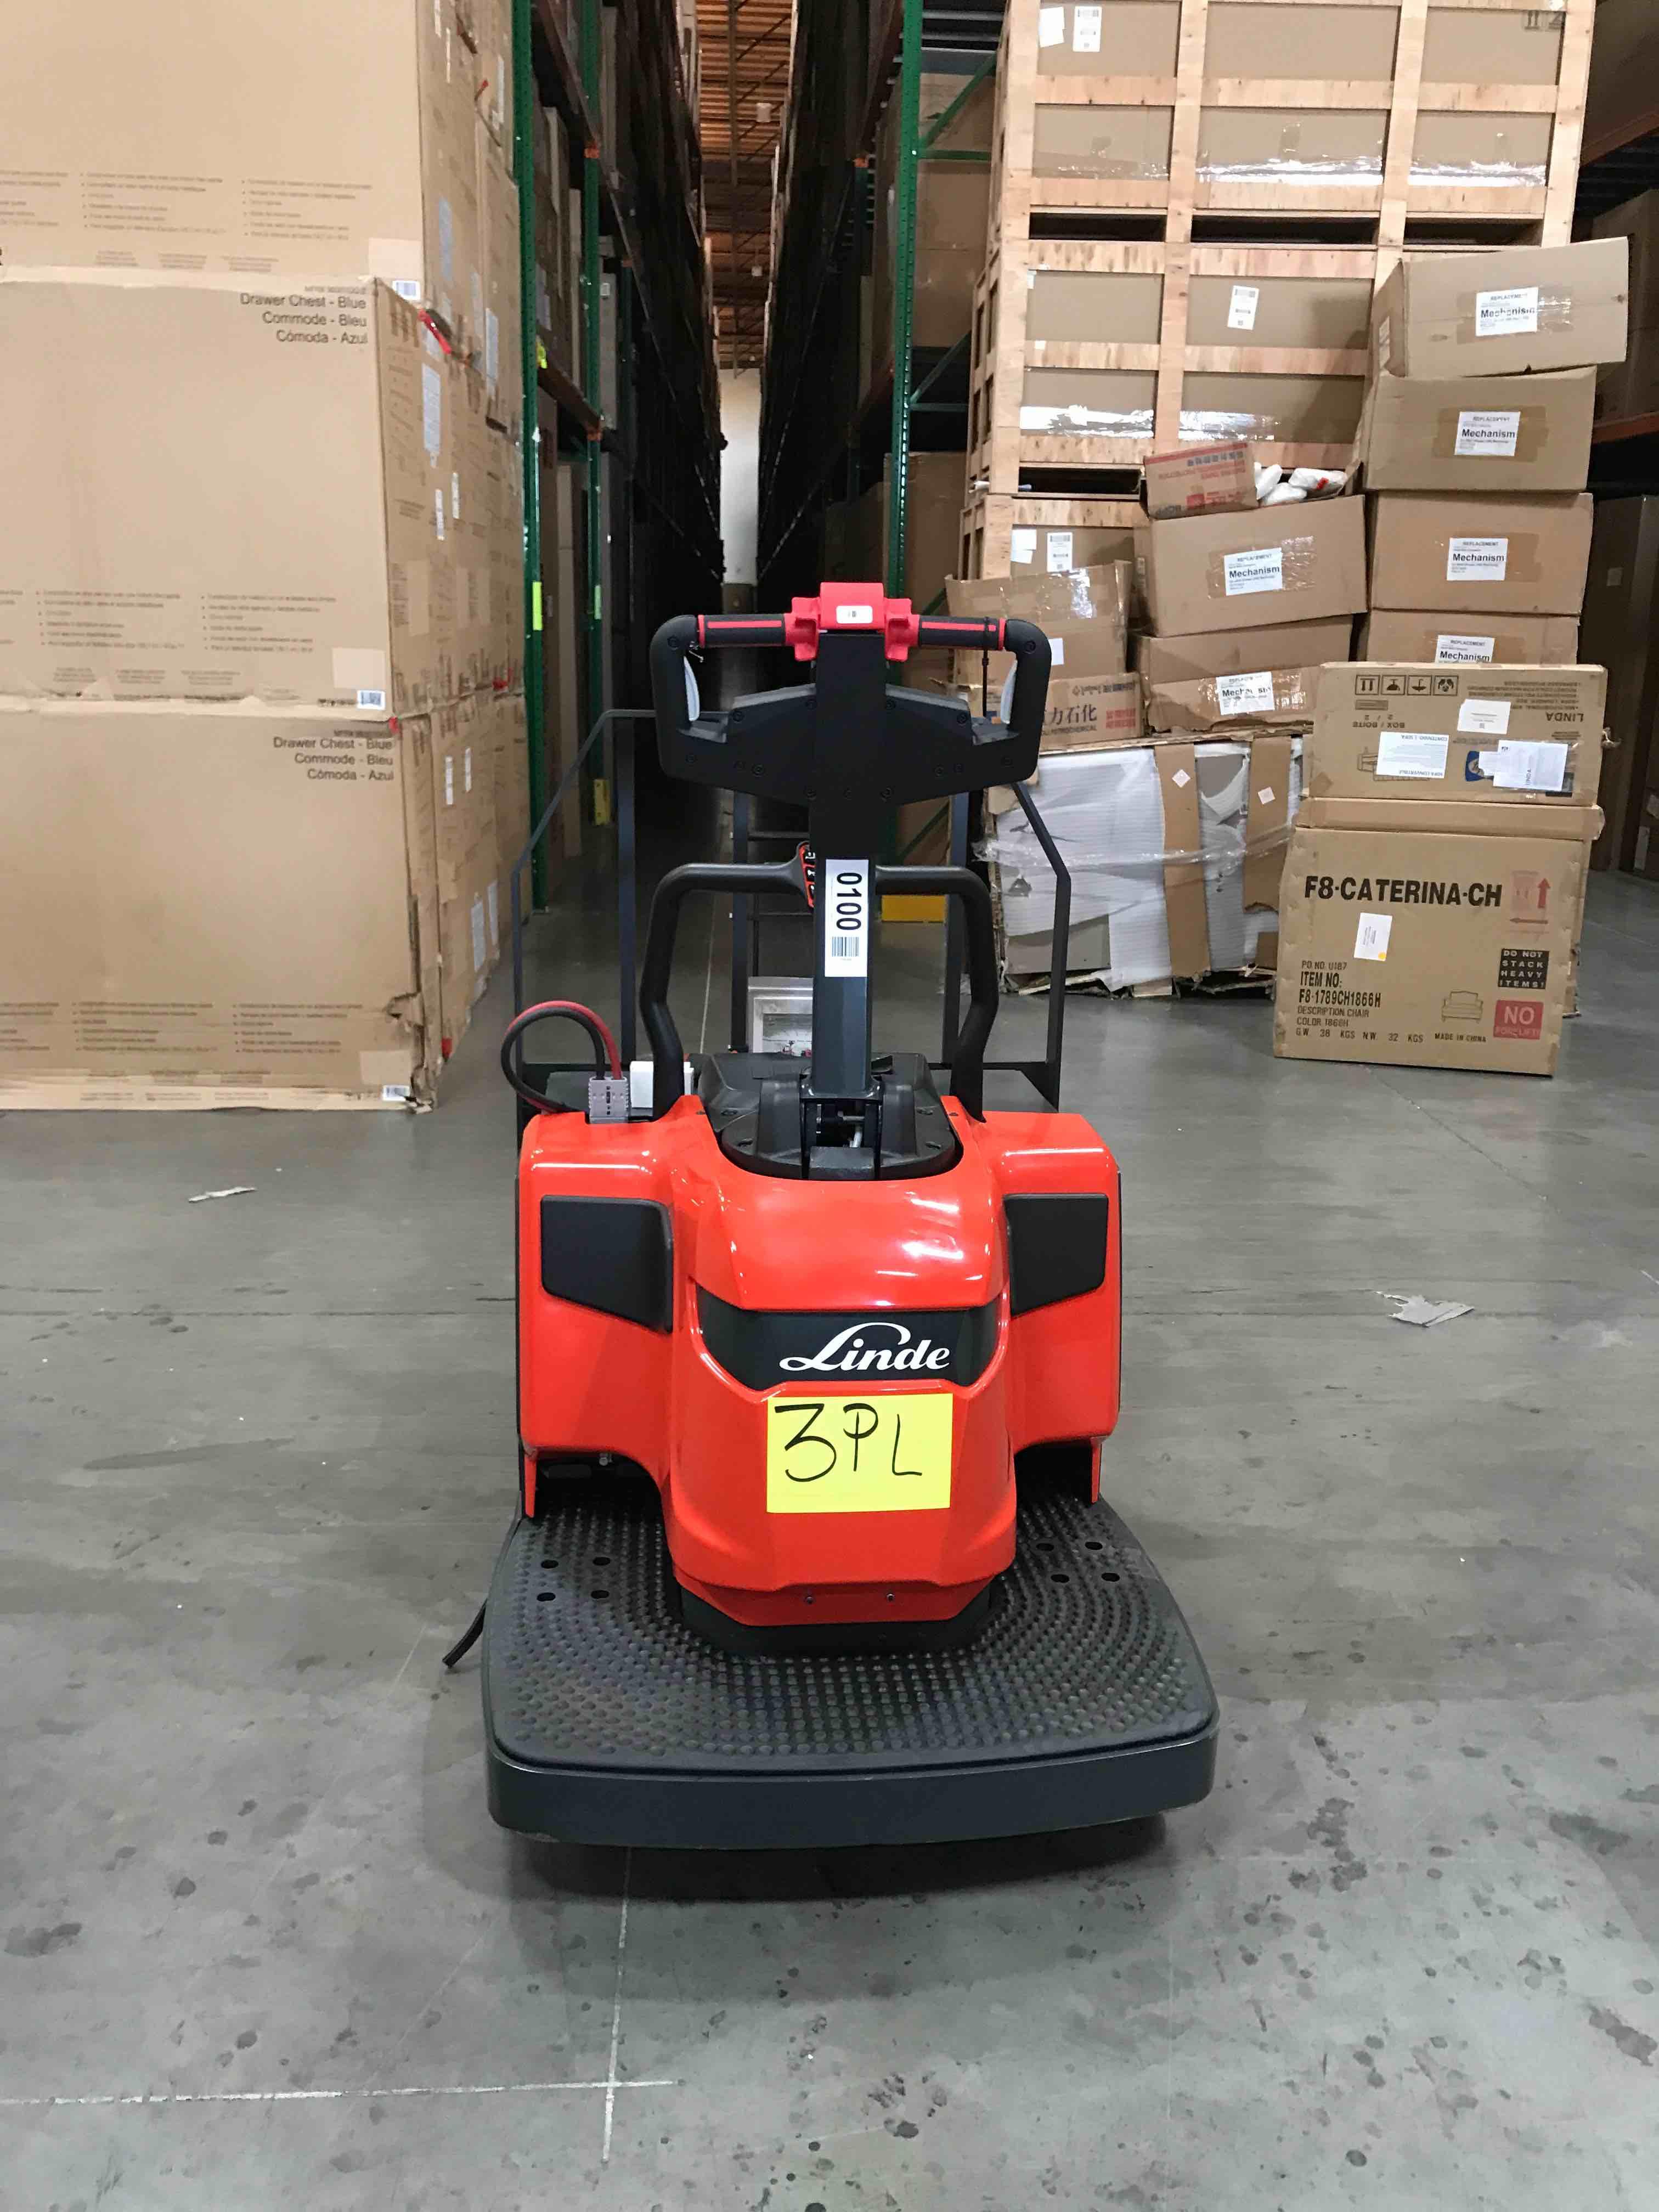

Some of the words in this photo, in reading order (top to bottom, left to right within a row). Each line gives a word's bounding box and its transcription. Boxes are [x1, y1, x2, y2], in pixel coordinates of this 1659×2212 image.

[240, 292, 285, 306] Drawer
[289, 294, 326, 307] Chest
[337, 296, 366, 309] Blue
[262, 311, 327, 326] Commode
[338, 314, 368, 328] Bleu
[276, 329, 329, 344] Cómoda
[341, 331, 368, 345] Azul
[1462, 428, 1515, 438] Mechanism
[1453, 553, 1504, 562] Mechanism
[1229, 566, 1280, 579] Mechanism
[1440, 651, 1490, 662] Mechanism
[1043, 703, 1097, 726] 力石化
[1545, 712, 1584, 723] LINDA
[273, 737, 316, 748] Drawer
[320, 738, 355, 749] Chest
[366, 739, 393, 750] Blue
[294, 753, 356, 765] Commode
[366, 754, 393, 765] Bleu
[307, 768, 357, 781] Cómoda
[368, 770, 394, 781] Azul
[836, 872, 862, 930] 0100
[1502, 960, 1544, 968] STACK
[1300, 971, 1323, 987] ITEM
[1325, 972, 1342, 988] NO:
[1500, 970, 1542, 978] HEAVY
[1499, 980, 1544, 988] ITEMS!
[1347, 1009, 1370, 1018] CHAIR
[1504, 1005, 1535, 1025] NO
[1296, 1017, 1322, 1026] COLOR
[1320, 1029, 1330, 1037] 38
[1340, 1030, 1356, 1039] KGS
[1389, 1033, 1399, 1041] 32
[1408, 1034, 1424, 1043] KGS
[1466, 1035, 1487, 1043] CHINA
[779, 1322, 950, 1371] Linde
[775, 1403, 922, 1482] 3PL
